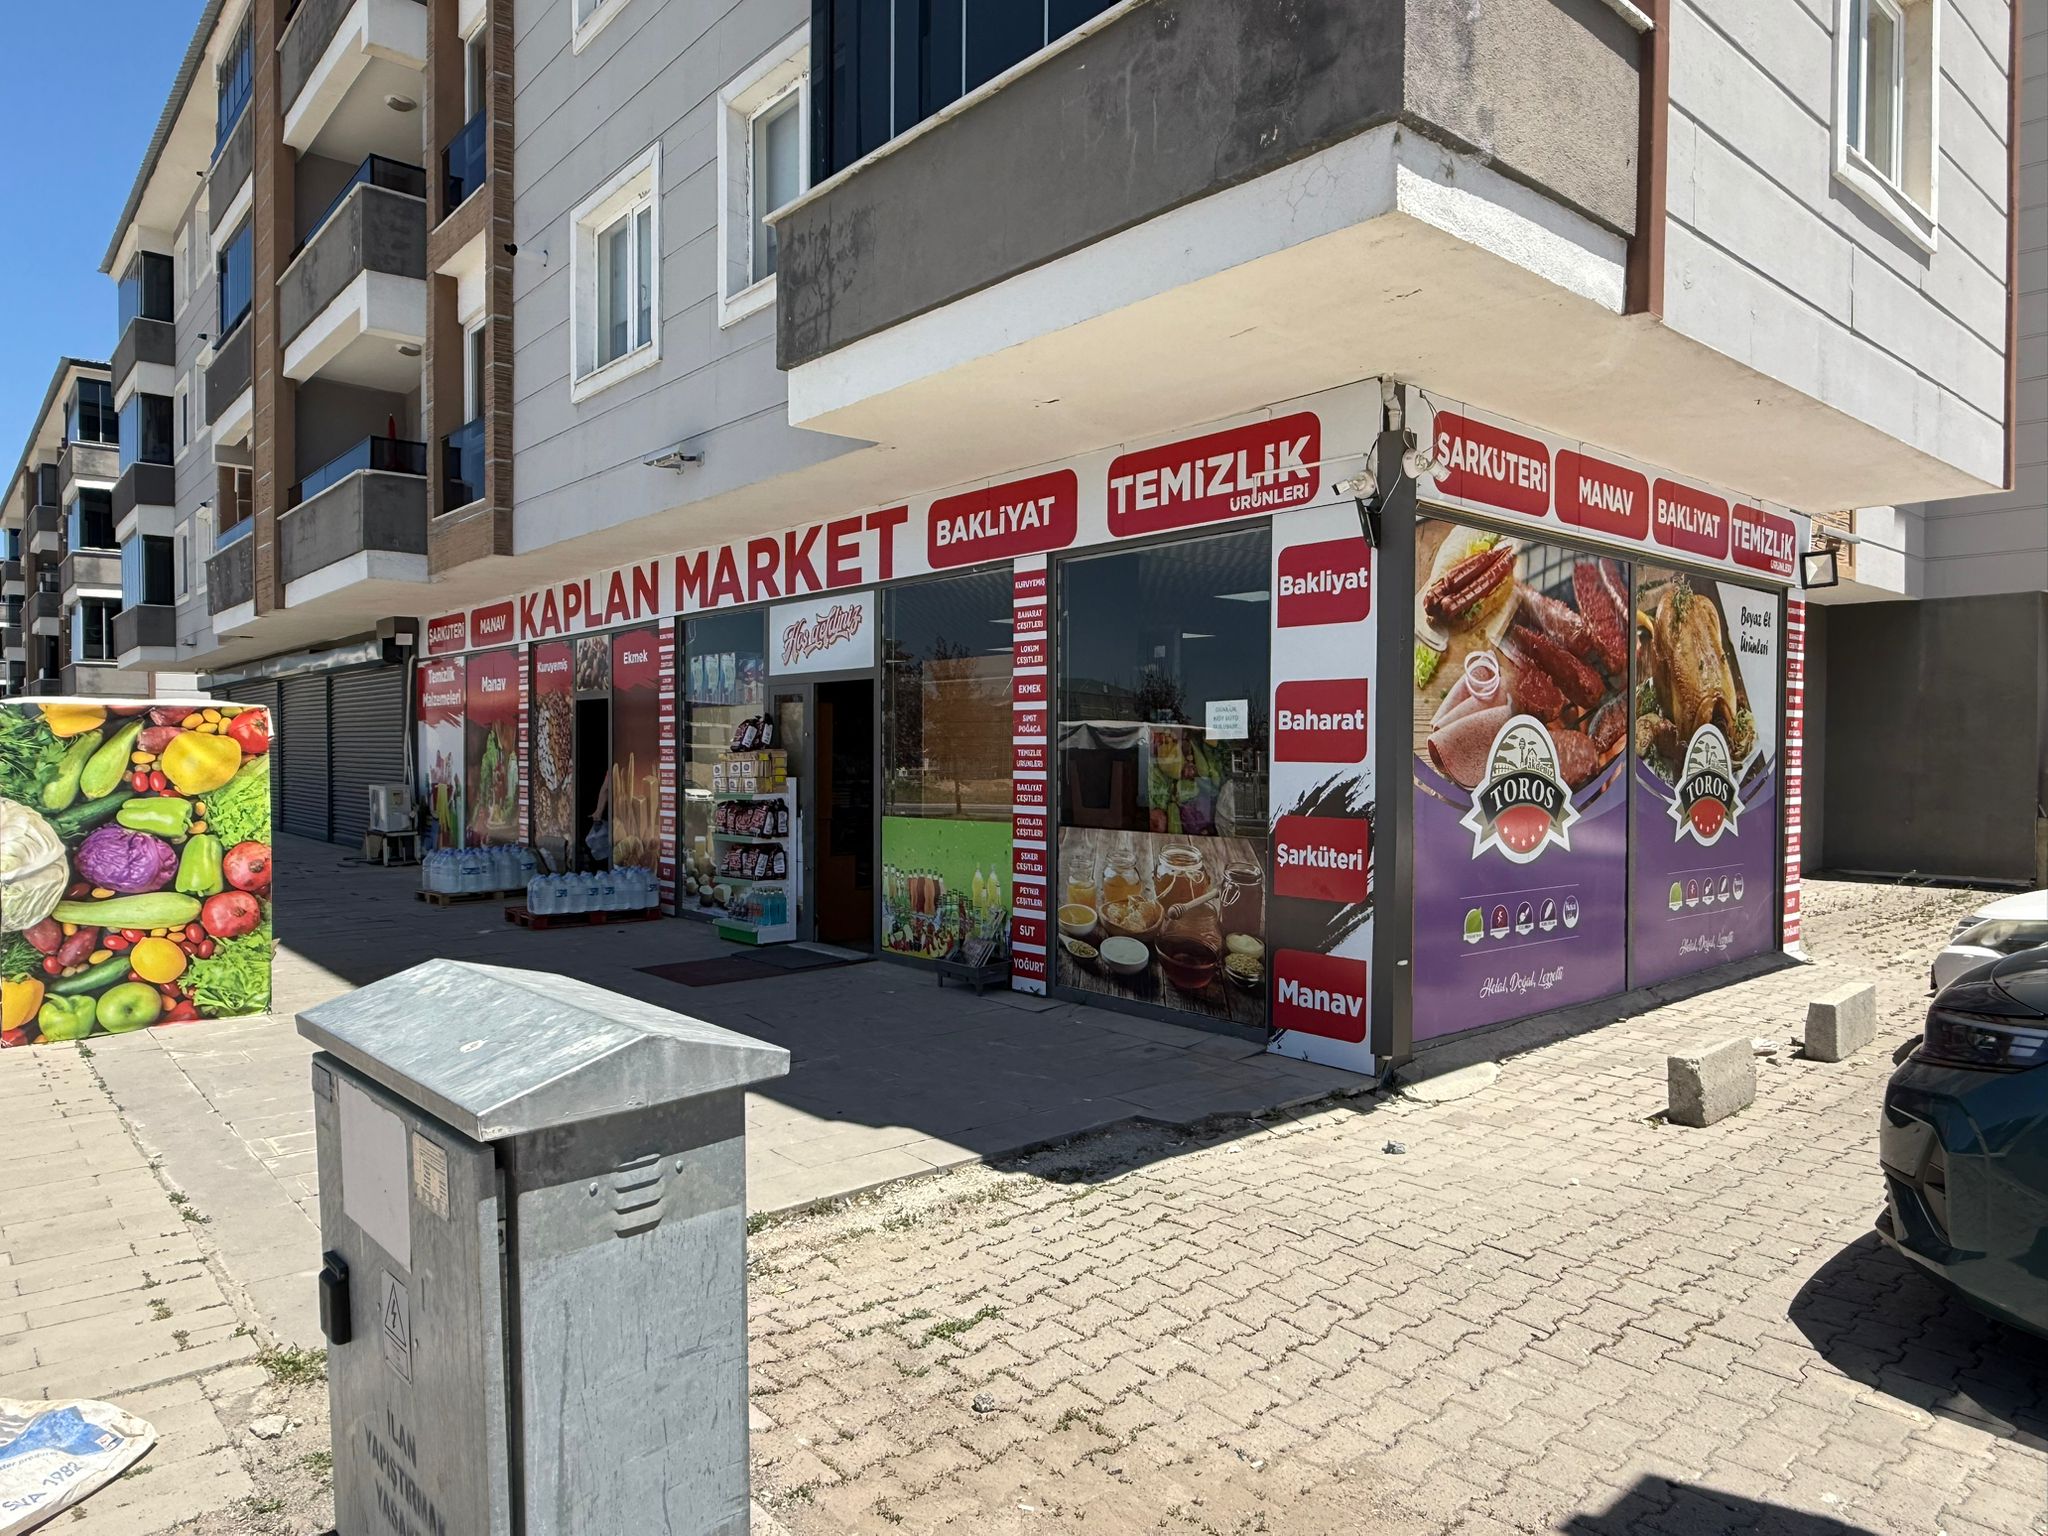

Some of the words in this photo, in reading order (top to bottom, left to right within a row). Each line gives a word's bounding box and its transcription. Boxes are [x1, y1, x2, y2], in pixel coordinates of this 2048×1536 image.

[1110, 434, 1311, 514] TEMİZLİK
[1579, 476, 1633, 517] MANAV
[936, 495, 1056, 547] BAKLİYAT
[1658, 498, 1721, 539] BAKLİYAT
[1733, 518, 1794, 562] TEMİZLİK
[520, 560, 659, 640] KAPLAN
[675, 505, 908, 612] MARKET
[1279, 567, 1368, 596] Bakliyat
[480, 615, 506, 634] MANAV
[1740, 606, 1762, 628] Beyaz
[1763, 611, 1771, 628] Et
[623, 649, 649, 665] Ekmek
[1740, 631, 1769, 656] Ürünleri
[481, 676, 506, 692] Manav
[1018, 684, 1041, 694] EKMEK
[1278, 708, 1365, 731] Baharat
[1490, 777, 1556, 812] TOROS
[1686, 775, 1729, 803] TOROS
[1276, 843, 1363, 871] Şarküteri
[1013, 957, 1045, 973] YOĞURT
[1278, 977, 1363, 1018] Manav
